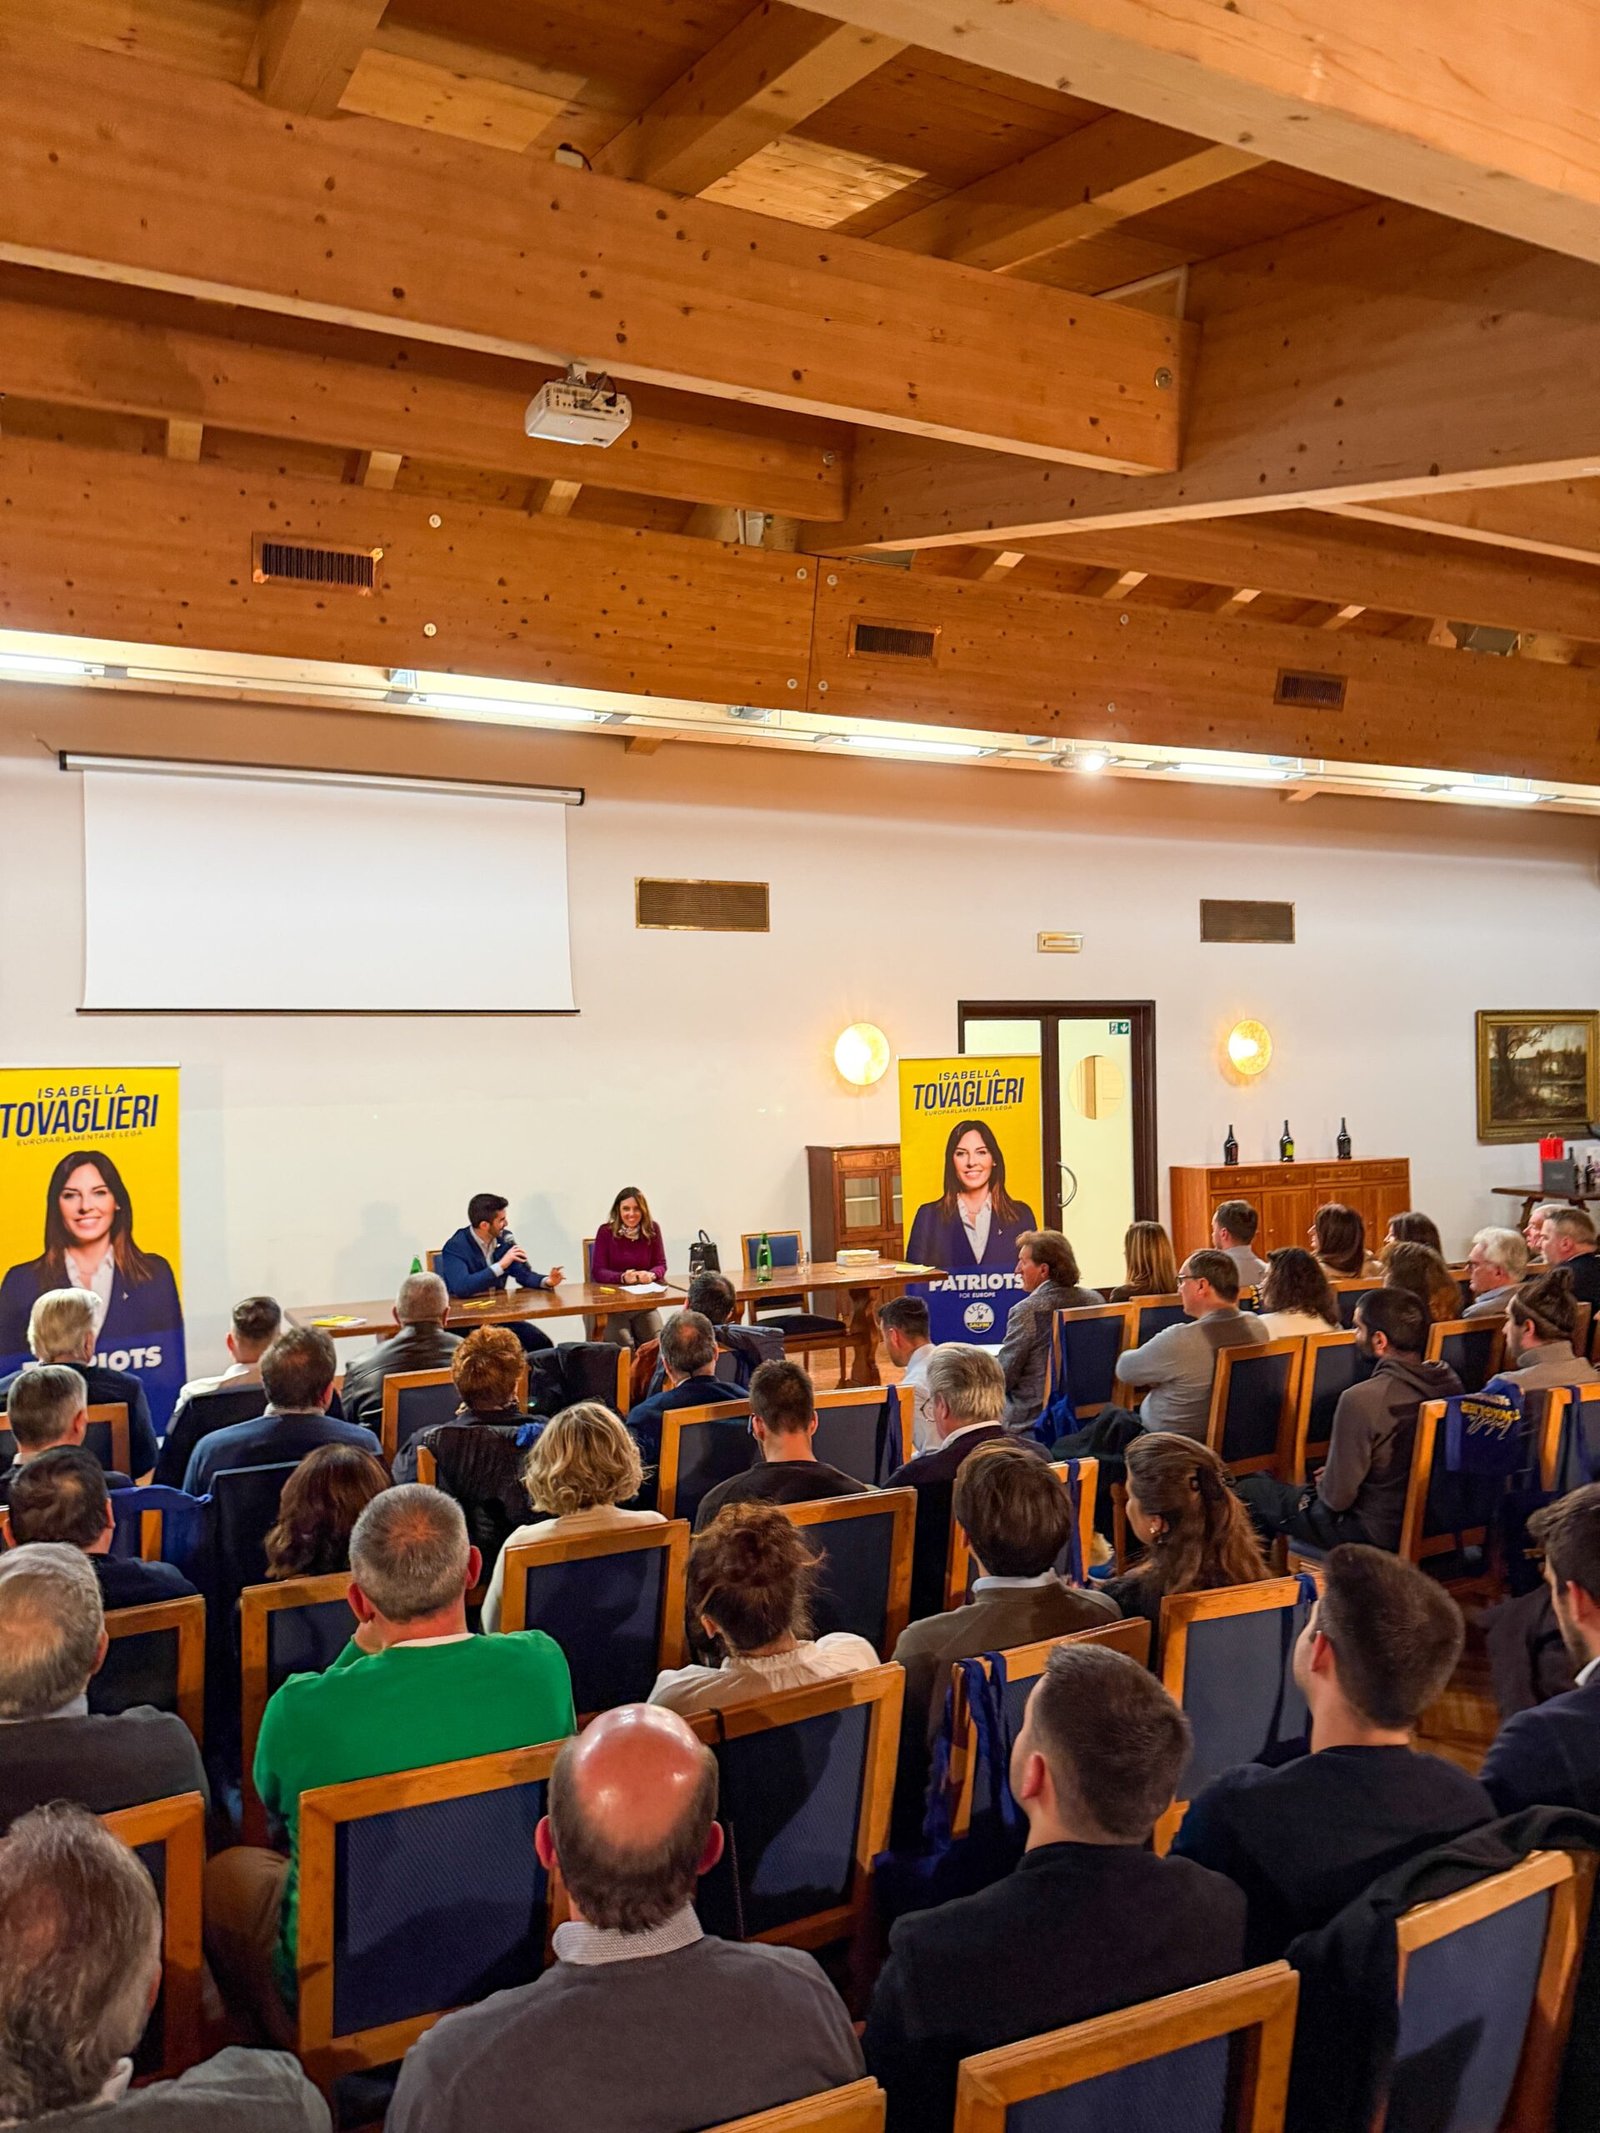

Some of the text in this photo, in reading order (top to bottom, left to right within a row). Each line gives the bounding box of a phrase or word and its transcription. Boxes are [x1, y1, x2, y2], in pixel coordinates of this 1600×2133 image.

[939, 1069, 1001, 1081] ISABELLA
[38, 1083, 126, 1099] ISABELLA
[913, 1077, 1025, 1110] TOVAGLIERI
[0, 1094, 159, 1139] TOVAGLIERI
[16, 1130, 143, 1147] EUROPARLAMENTARE LEGA
